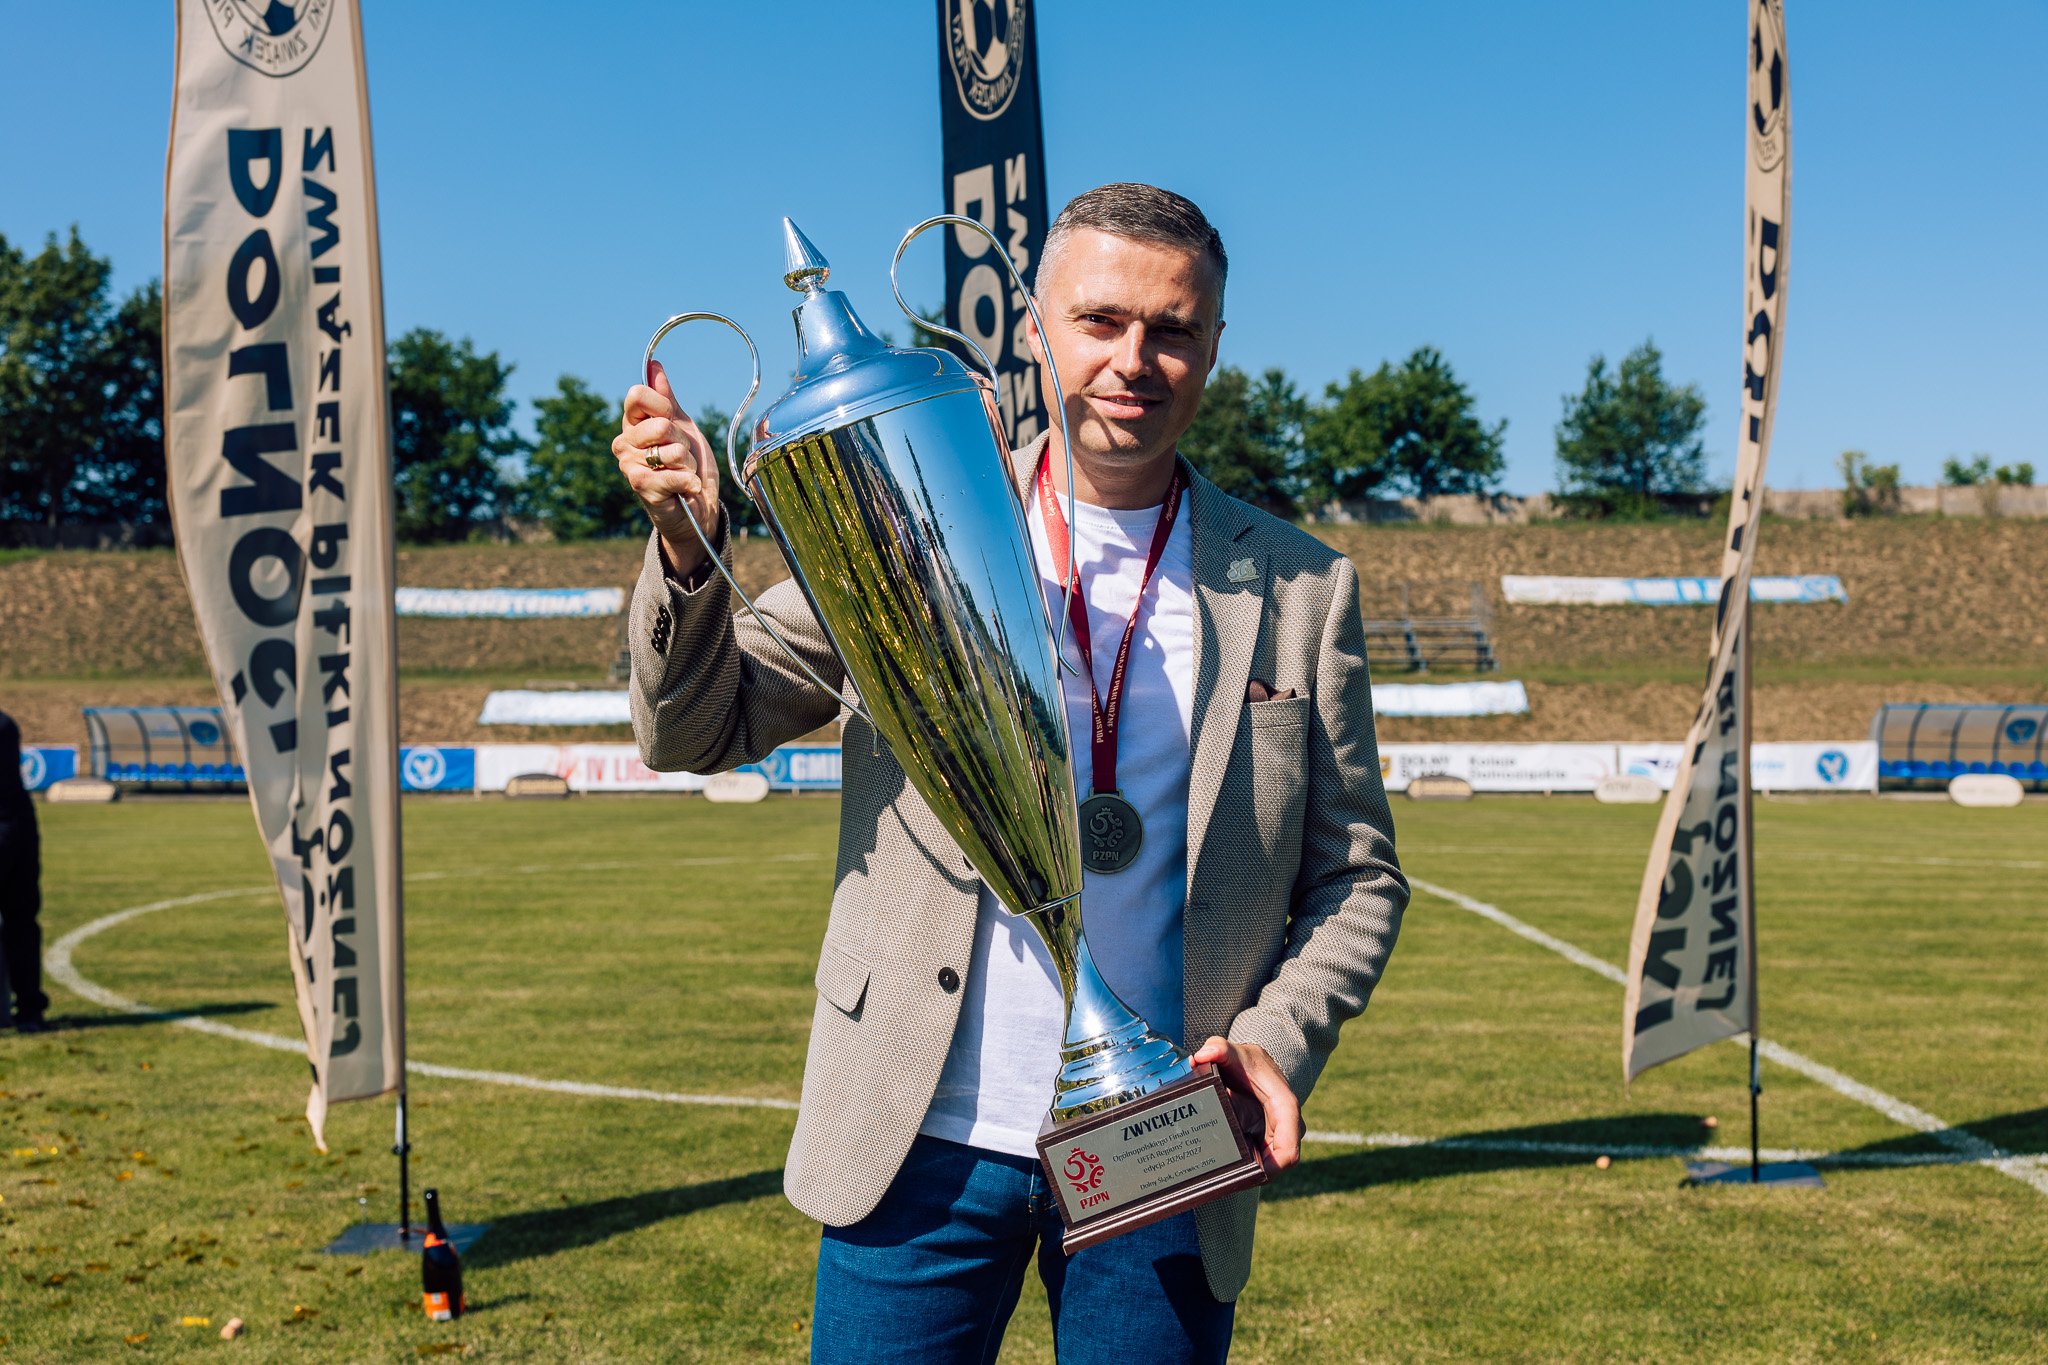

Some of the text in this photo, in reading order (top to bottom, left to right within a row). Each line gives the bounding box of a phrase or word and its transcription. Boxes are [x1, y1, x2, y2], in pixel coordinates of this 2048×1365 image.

[1092, 850, 1119, 861] PZPN
[1121, 1103, 1198, 1141] ZWYCIĘZCA
[1112, 1137, 1168, 1163] Ogólnopolskiego
[1191, 1118, 1219, 1136] Turnieju
[1137, 1153, 1156, 1164] UEFA
[1143, 1160, 1166, 1174] edycja
[1140, 1179, 1157, 1191] Dolny
[1079, 1190, 1110, 1210] PZPN
